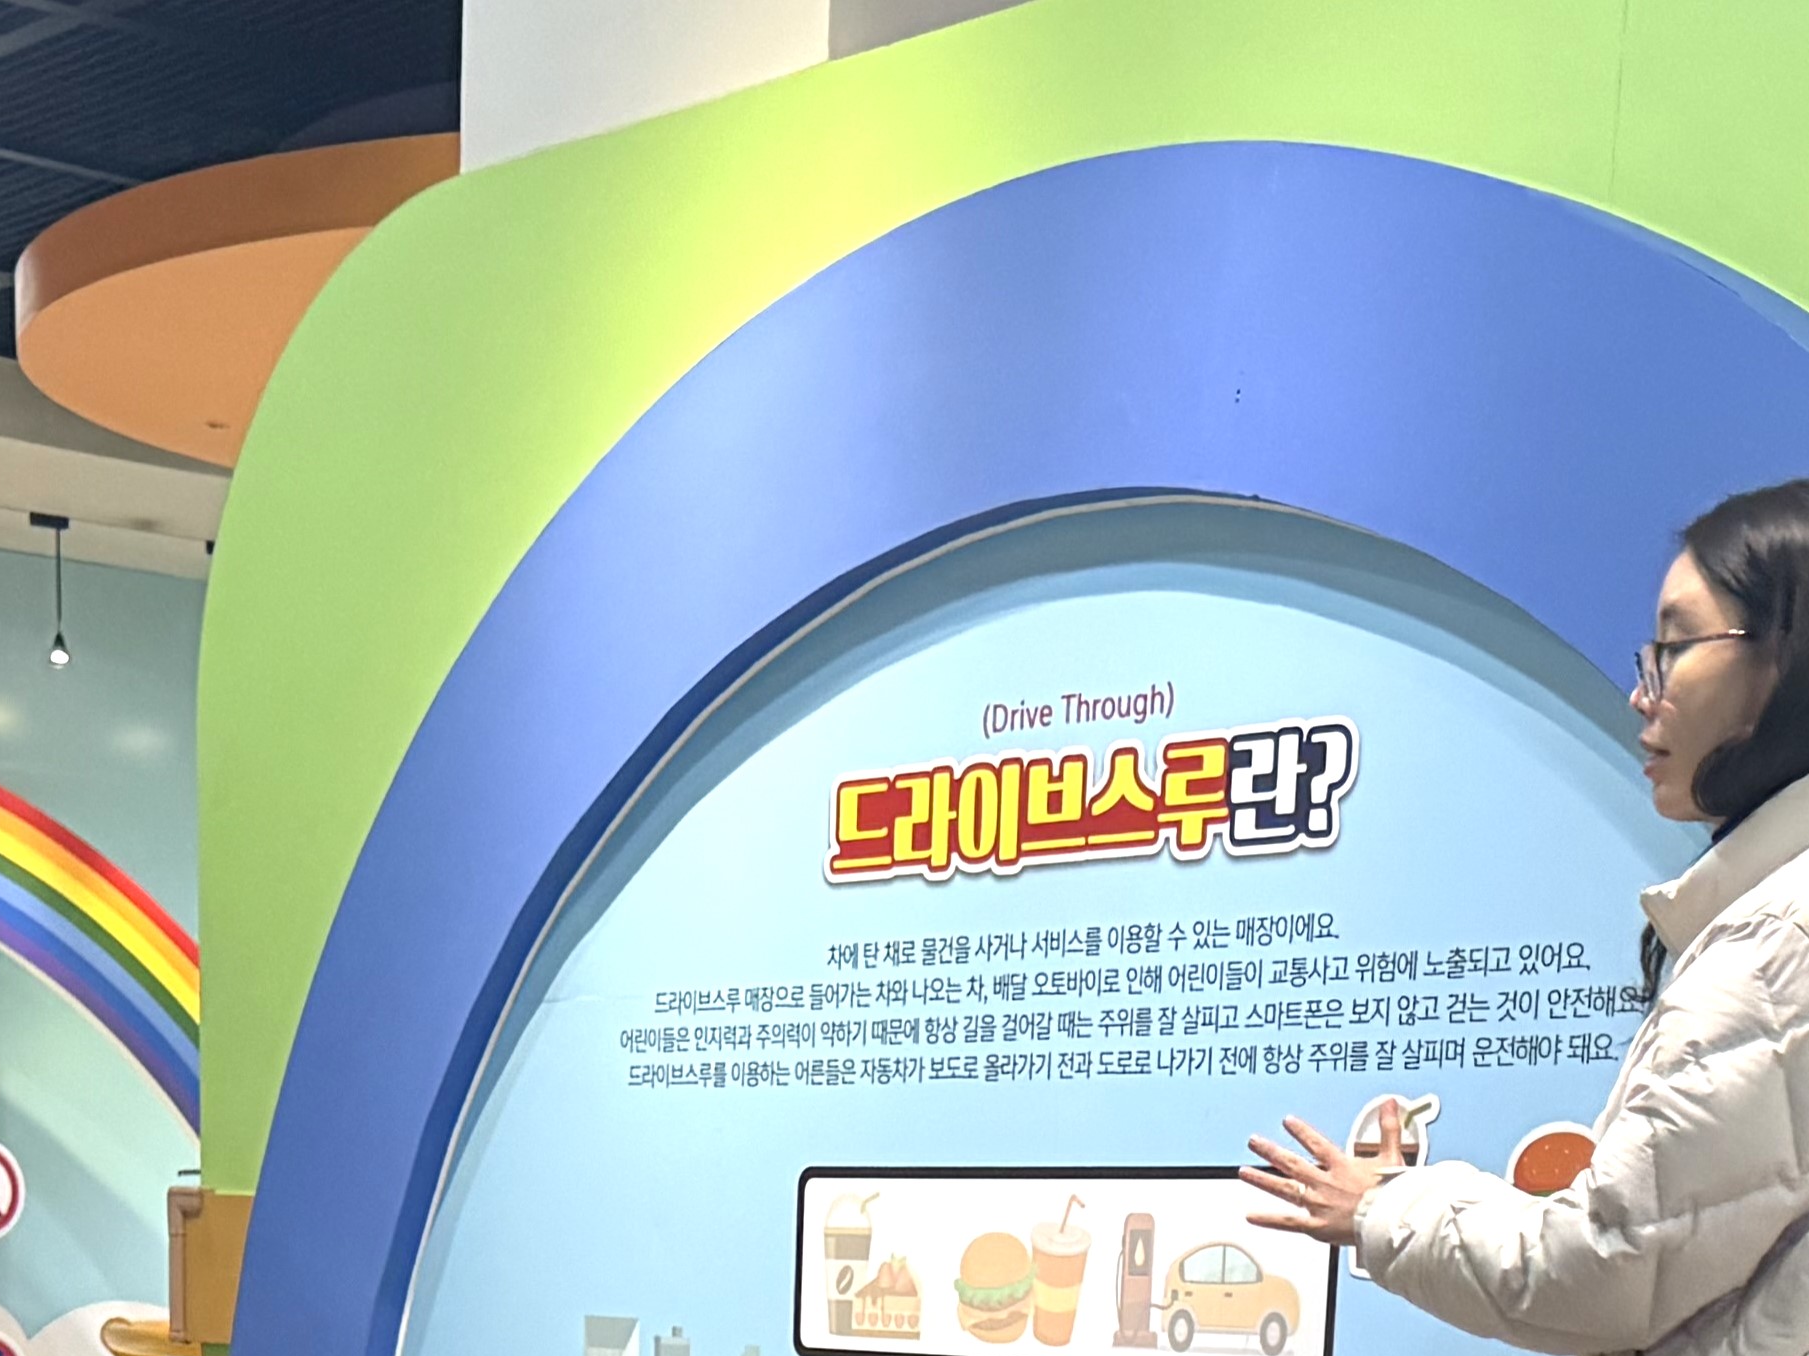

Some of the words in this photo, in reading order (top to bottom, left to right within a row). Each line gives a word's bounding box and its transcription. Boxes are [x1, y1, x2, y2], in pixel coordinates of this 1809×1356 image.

[982, 700, 1053, 740] (Drive
[1061, 681, 1176, 727] Through)
[830, 724, 1353, 876] 드라이브스루란?
[826, 942, 859, 971] 차에
[863, 941, 880, 970] 탄
[882, 939, 917, 967] 채로
[920, 935, 972, 967] 물건을
[974, 931, 1028, 963] 사거나
[1030, 926, 1103, 960] 서비스를
[1107, 921, 1164, 956] 이용할
[1166, 920, 1188, 952] 수
[1192, 918, 1232, 951] 있는
[1235, 912, 1340, 947] 매장이에요.
[654, 987, 742, 1016] 드라이브스루
[744, 985, 806, 1013] 매장으로
[808, 980, 873, 1011] 들어가는
[874, 978, 909, 1008] 차와
[911, 976, 963, 1006] 나오는
[965, 973, 989, 1005] 차,
[992, 972, 1028, 1002] 배달
[1031, 967, 1121, 999] 오토바이로
[1125, 964, 1163, 996] 인해
[1167, 958, 1263, 994] 어린이들이
[1267, 955, 1350, 989] 교통사고
[1354, 949, 1419, 984] 위험에
[1422, 945, 1512, 980] 노출되고
[1518, 941, 1591, 976] 있어요.
[619, 1026, 691, 1054] 어린이들은
[693, 1023, 753, 1052] 인지력과
[755, 1021, 816, 1050] 주의력이
[819, 1019, 868, 1048] 약하기
[871, 1017, 920, 1046] 때문에
[924, 1015, 959, 1045] 항상
[962, 1013, 998, 1044] 길을
[1001, 1010, 1054, 1043] 걸어갈
[1057, 1010, 1094, 1039] 때는
[1097, 1006, 1154, 1038] 주위를
[1157, 1005, 1178, 1037] 잘
[1181, 1003, 1240, 1036] 살피고
[1243, 998, 1345, 1032] 스마트폰은
[1348, 995, 1391, 1028] 보지
[1396, 994, 1441, 1027] 않고
[1446, 992, 1491, 1025] 걷는
[1496, 988, 1540, 1023] 것이
[627, 1061, 728, 1089] 드라이브스루를
[730, 1060, 791, 1088] 이용하는
[794, 1058, 857, 1087] 어른들은
[859, 1056, 926, 1085] 자동차가
[928, 1055, 980, 1080] 보도로
[983, 1051, 1052, 1083] 올라가기
[1056, 1050, 1094, 1080] 전과
[1096, 1049, 1153, 1076] 도로로
[1156, 1045, 1213, 1078] 나가기
[1218, 1044, 1258, 1076] 전에
[1262, 1043, 1304, 1075] 항상
[1307, 1040, 1370, 1074] 주위를
[1375, 1039, 1398, 1072] 잘
[1401, 1036, 1466, 1071] 살피며
[1471, 1033, 1564, 1068] 운전해야
[1566, 1032, 1622, 1065] 돼요.
